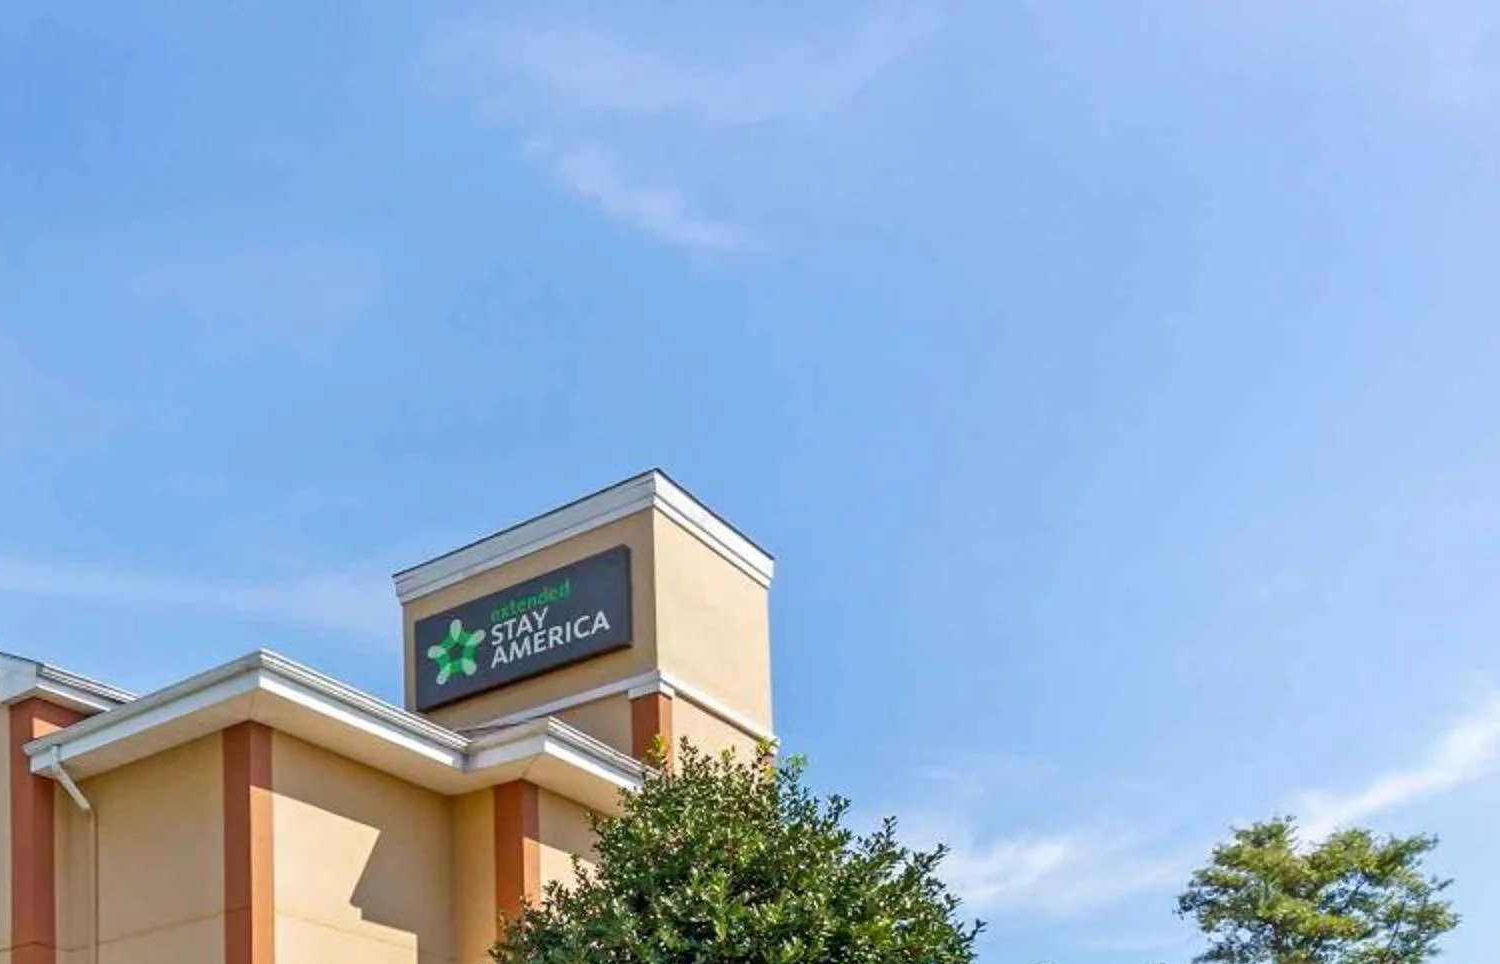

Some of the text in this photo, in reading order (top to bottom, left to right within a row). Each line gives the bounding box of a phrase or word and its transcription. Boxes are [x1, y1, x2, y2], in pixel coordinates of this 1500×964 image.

[491, 577, 570, 622] extended
[490, 610, 611, 669] AMERICA
[491, 605, 549, 646] STAY
